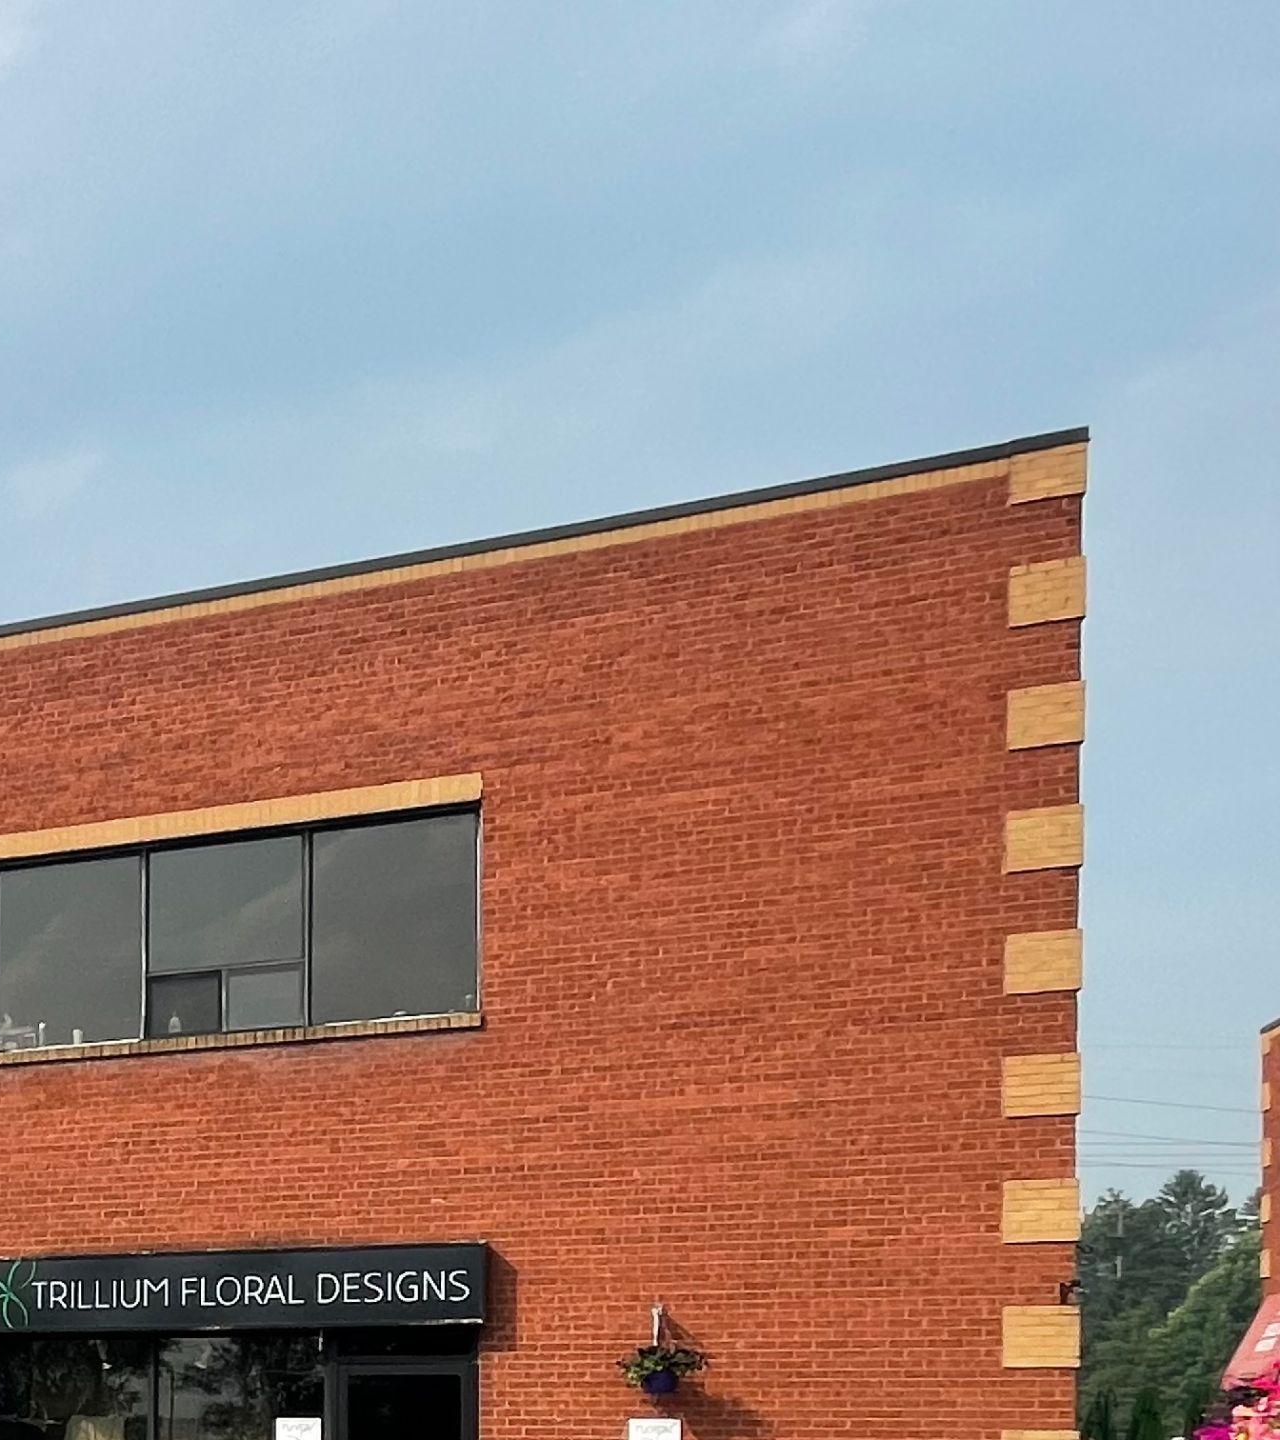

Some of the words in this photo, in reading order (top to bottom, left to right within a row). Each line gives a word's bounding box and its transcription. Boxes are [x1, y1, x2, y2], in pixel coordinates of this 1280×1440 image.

[31, 1278, 169, 1310] TRILLIUM
[181, 1275, 305, 1308] FLORAL
[317, 1270, 471, 1304] DESIGNS
